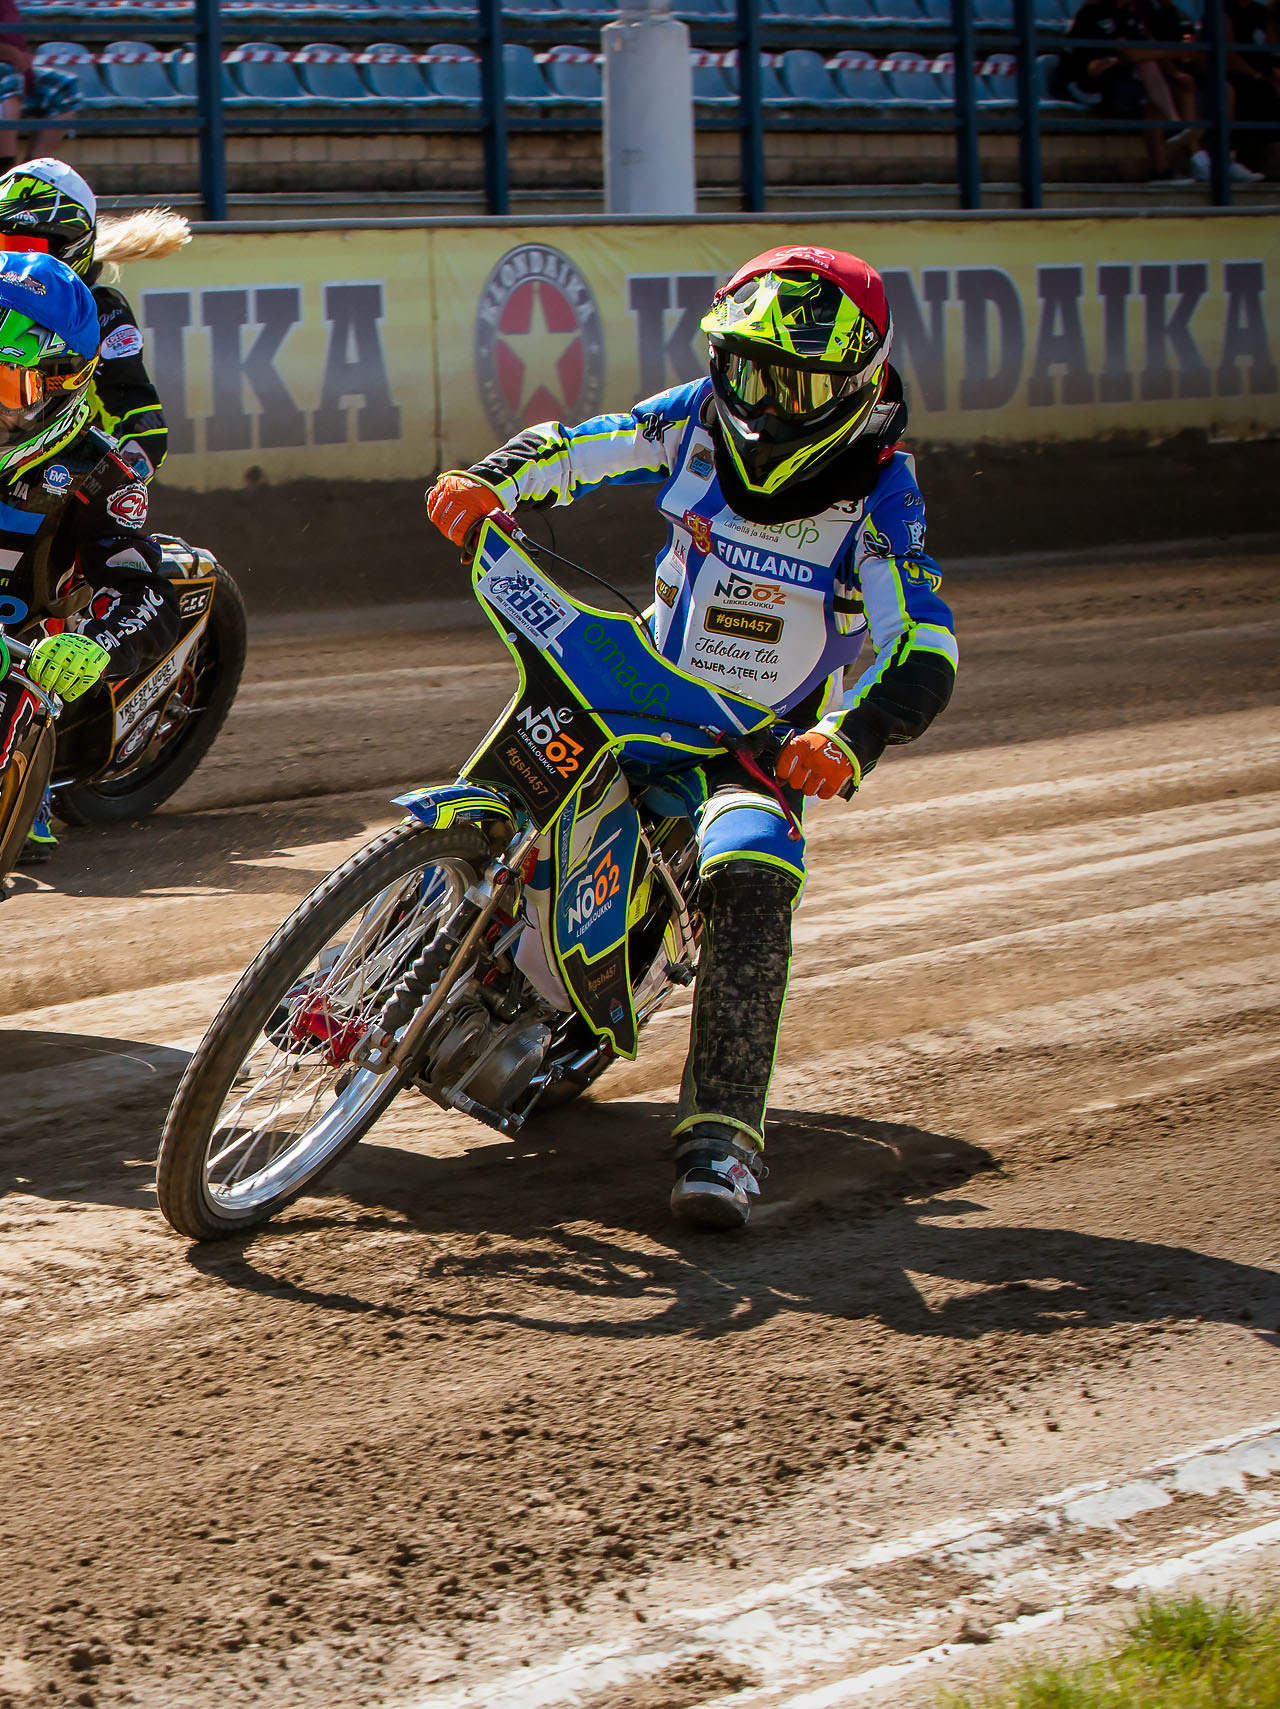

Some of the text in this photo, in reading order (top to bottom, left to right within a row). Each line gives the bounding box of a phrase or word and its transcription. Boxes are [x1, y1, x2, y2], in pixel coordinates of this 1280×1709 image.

[717, 540, 813, 583] FINLAND
[506, 589, 562, 639] BSL
[716, 613, 772, 633] #gsh457
[722, 599, 775, 610] LIEKKILOUKKU
[118, 655, 176, 721] YRKESPLUGGET
[691, 657, 778, 683] POWER STEEL OY
[506, 747, 549, 795] #gsh457
[517, 728, 556, 775] LIEKKILOUKKU
[576, 900, 613, 938] LIEKKILOUKKU
